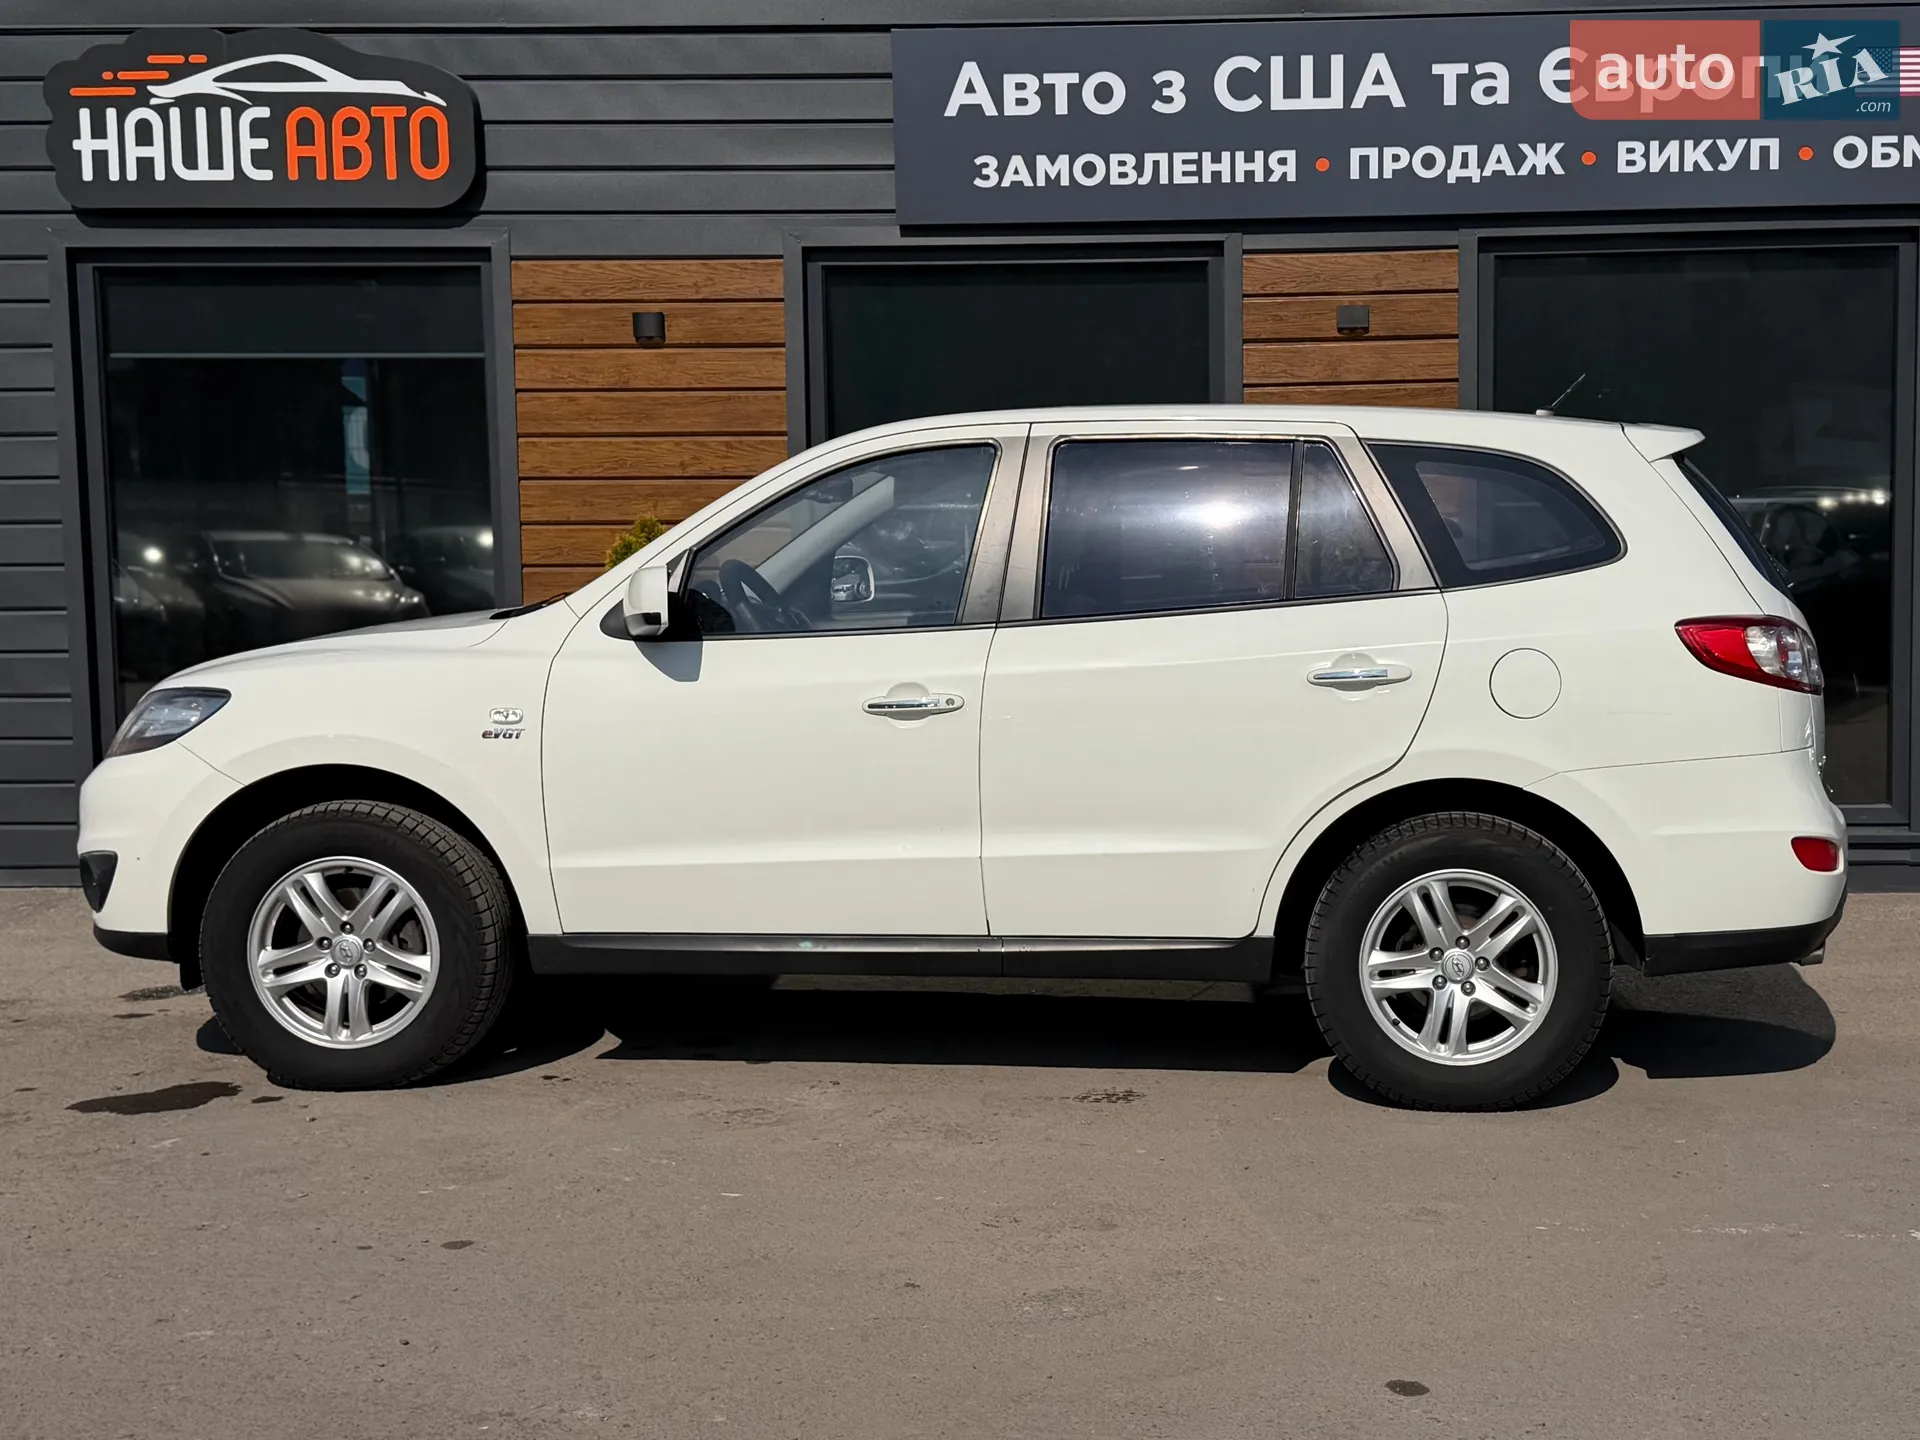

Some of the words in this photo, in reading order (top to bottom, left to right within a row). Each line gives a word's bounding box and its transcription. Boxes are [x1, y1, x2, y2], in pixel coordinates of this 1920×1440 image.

[944, 61, 1127, 117] Авто
[1151, 69, 1187, 114] з
[1214, 52, 1407, 113] США
[1432, 61, 1510, 106] та
[72, 106, 274, 182] НАШЕ
[286, 105, 450, 181] АВТО
[973, 149, 1297, 189] ЗАМОВЛЕННЯ
[1349, 143, 1566, 184] ПРОДАЖ
[1616, 137, 1780, 174] ВИКУП
[481, 727, 526, 740] eVGT
